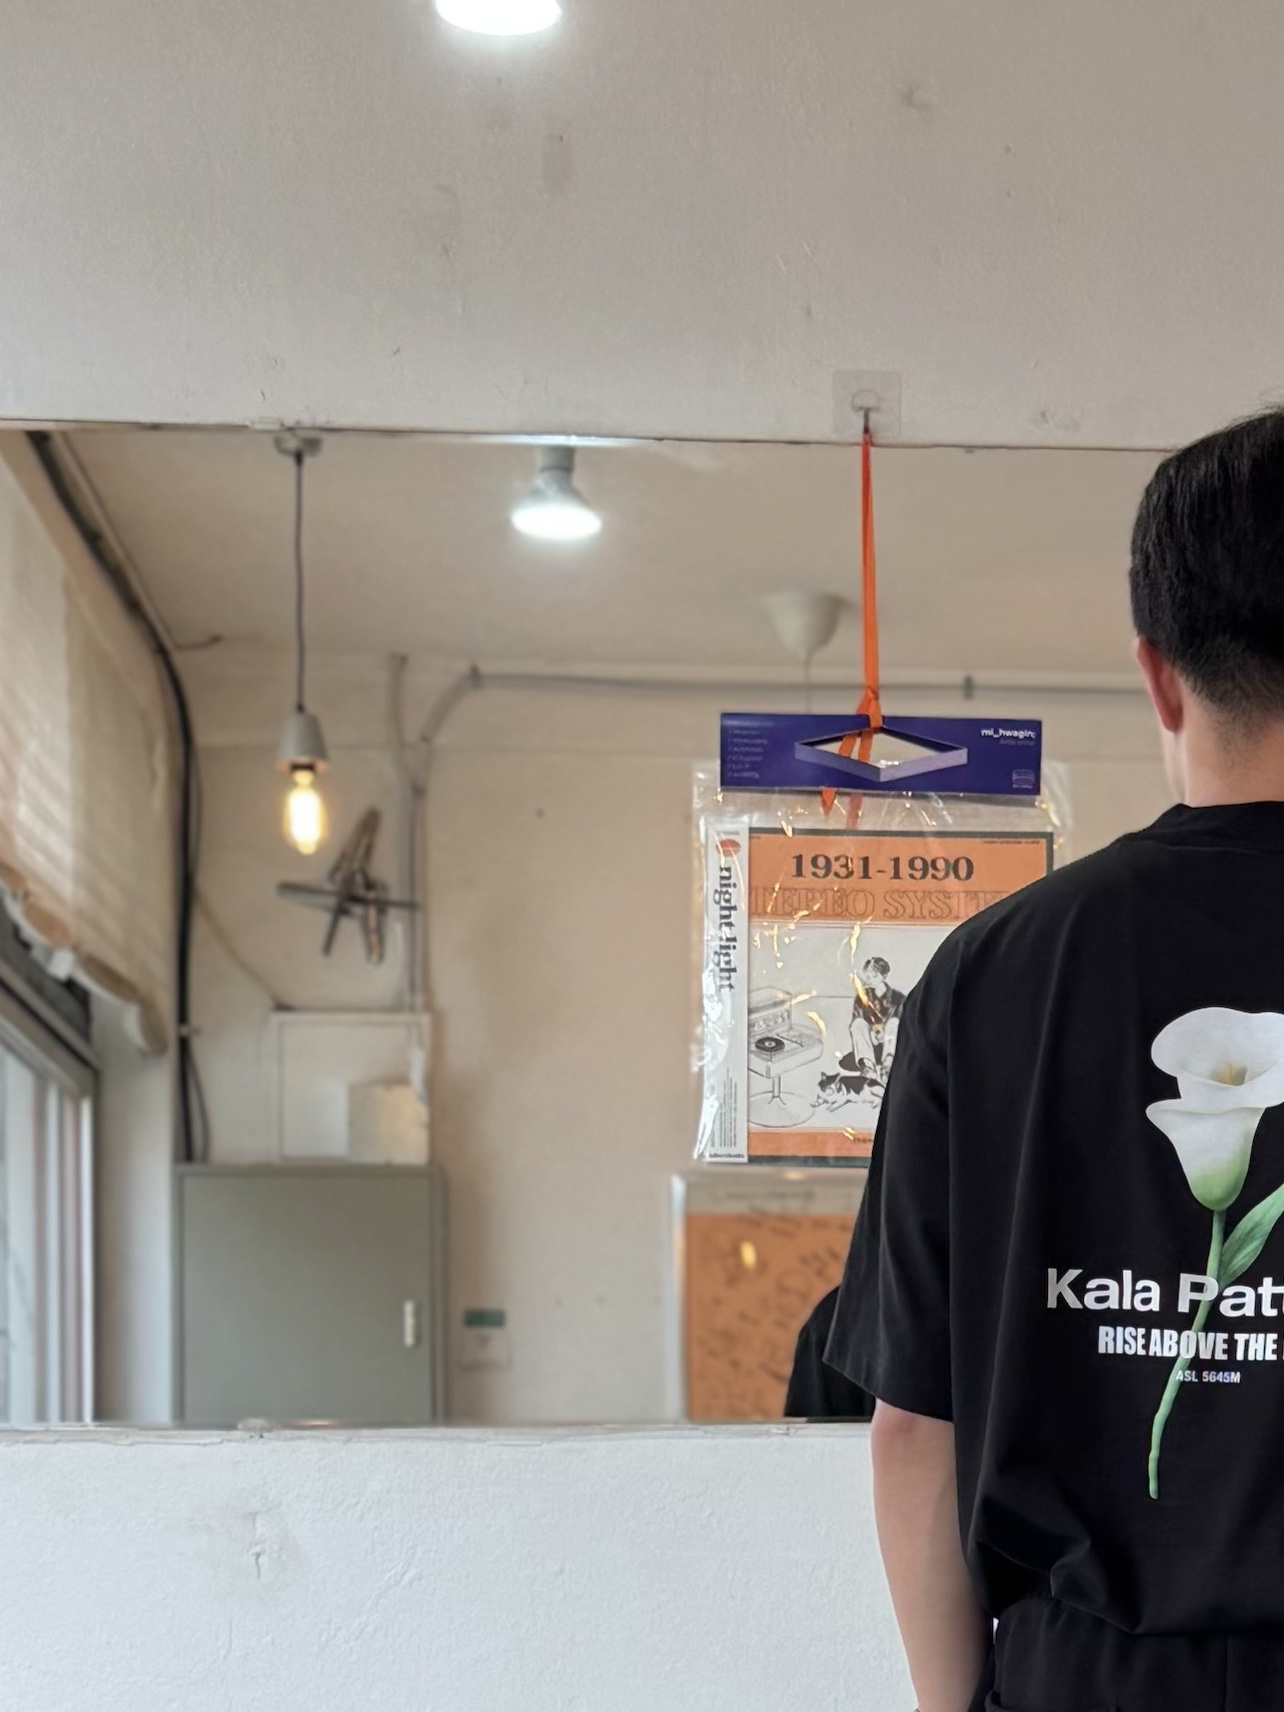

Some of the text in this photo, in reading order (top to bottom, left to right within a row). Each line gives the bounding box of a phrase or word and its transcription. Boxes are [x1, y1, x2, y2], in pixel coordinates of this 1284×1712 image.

[792, 854, 974, 881] 1931-1990
[713, 866, 738, 992] night light
[1047, 1268, 1160, 1312] Kala
[1098, 1326, 1146, 1355] RISE
[1149, 1329, 1228, 1360] ABOVE
[1234, 1332, 1278, 1361] THE
[1176, 1370, 1241, 1383] ASL 5645M
